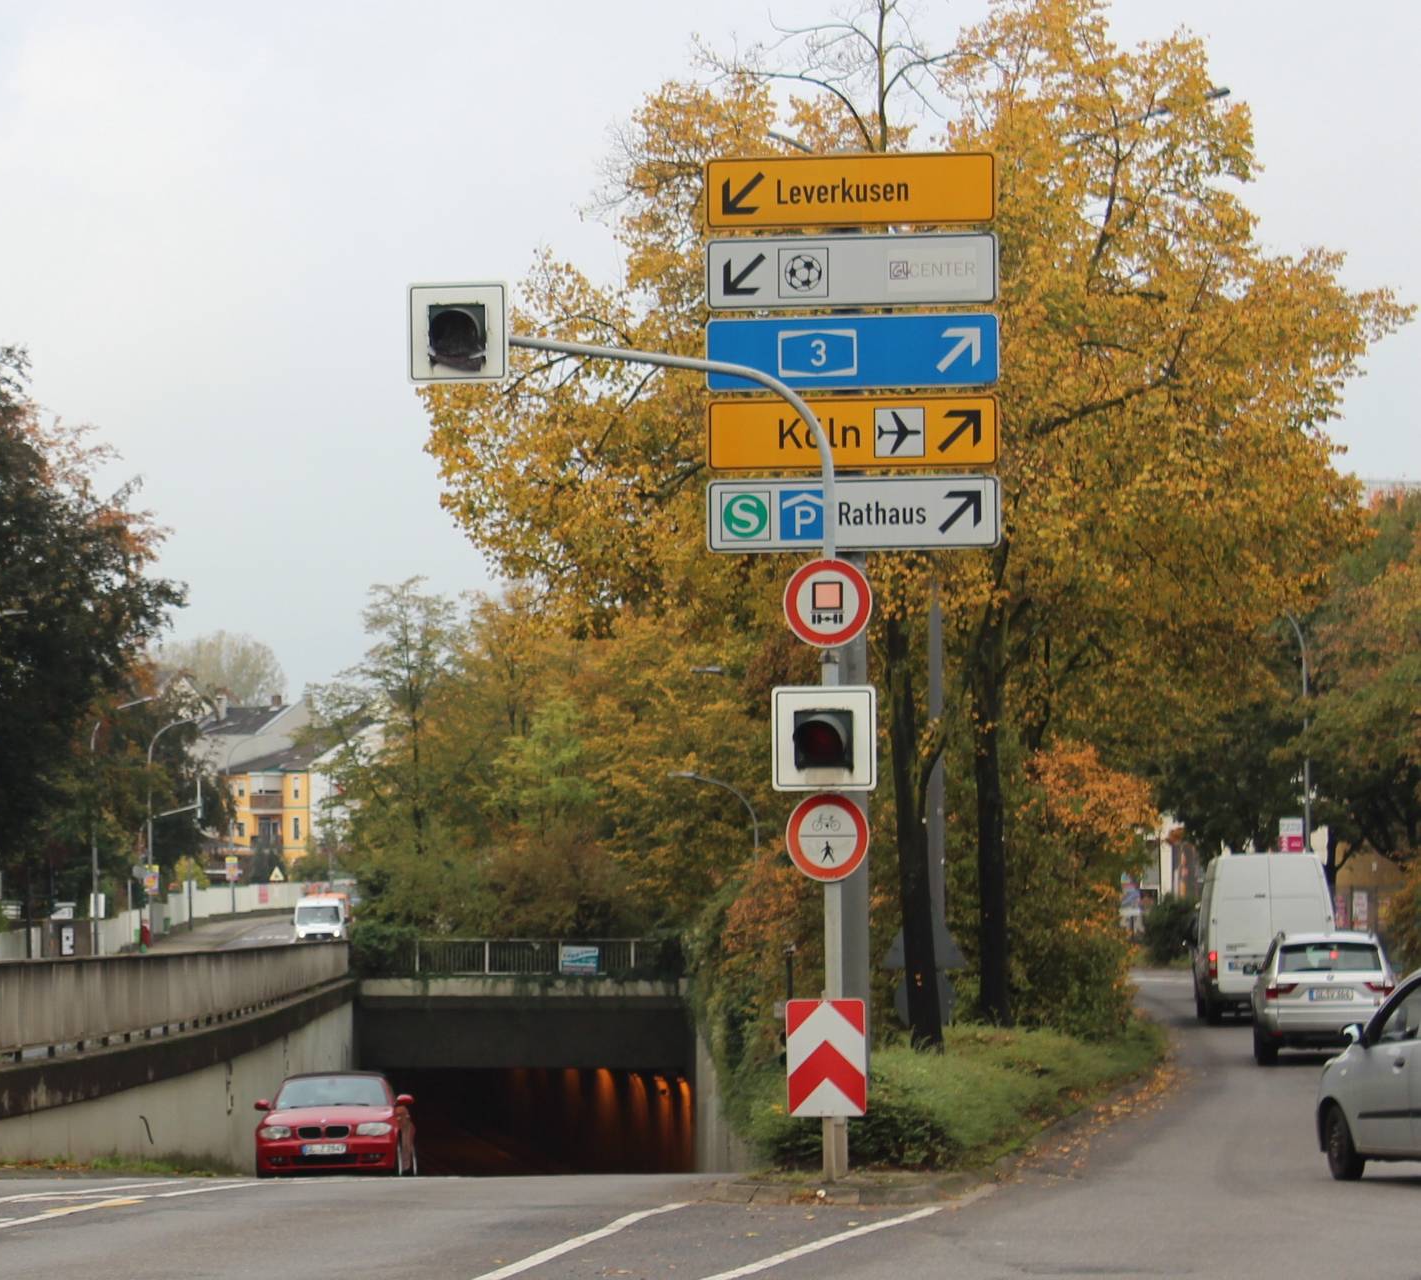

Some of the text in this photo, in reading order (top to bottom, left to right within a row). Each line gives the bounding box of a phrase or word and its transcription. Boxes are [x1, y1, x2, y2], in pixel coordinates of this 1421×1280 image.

[777, 178, 909, 205] Leverkusen
[910, 262, 976, 279] CENTER
[810, 339, 827, 367] 3
[732, 499, 927, 536] S P Rathaus
